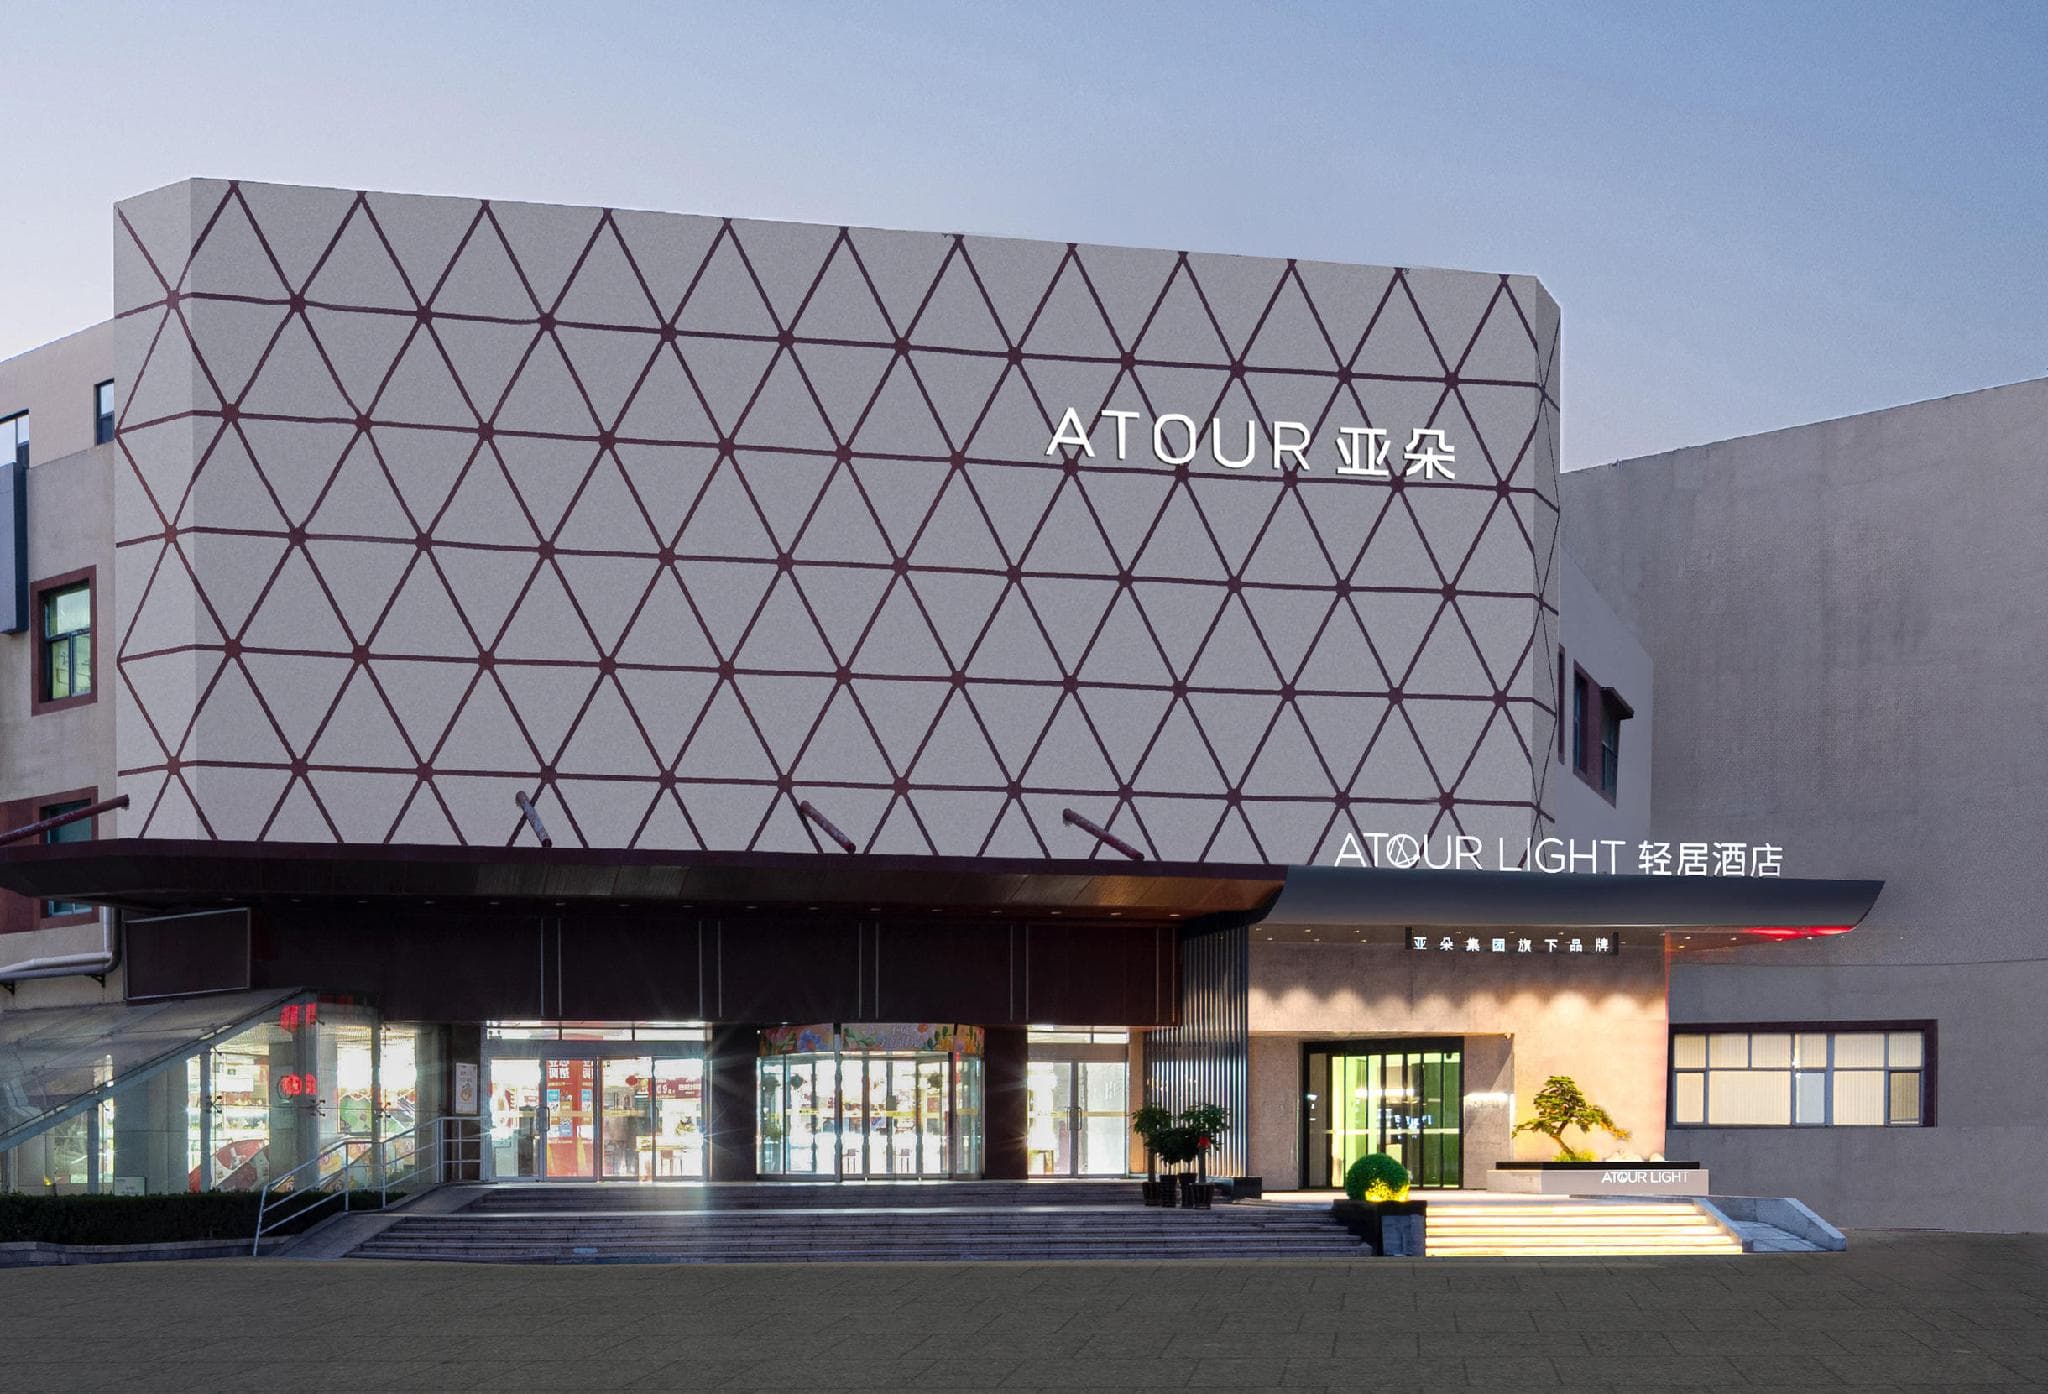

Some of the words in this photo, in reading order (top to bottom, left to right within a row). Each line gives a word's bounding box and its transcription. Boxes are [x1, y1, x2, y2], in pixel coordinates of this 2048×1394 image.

[1045, 407, 1311, 470] ATOUR
[1335, 426, 1456, 479] 亚朵
[1334, 832, 1483, 870] ATOUR
[1499, 837, 1626, 874] LIGHT
[1638, 839, 1784, 877] 轻居酒店
[1413, 936, 1609, 953] 亚朵集团旗下品牌
[1601, 1171, 1648, 1184] ATOUR
[1650, 1171, 1689, 1184] LIGHT
